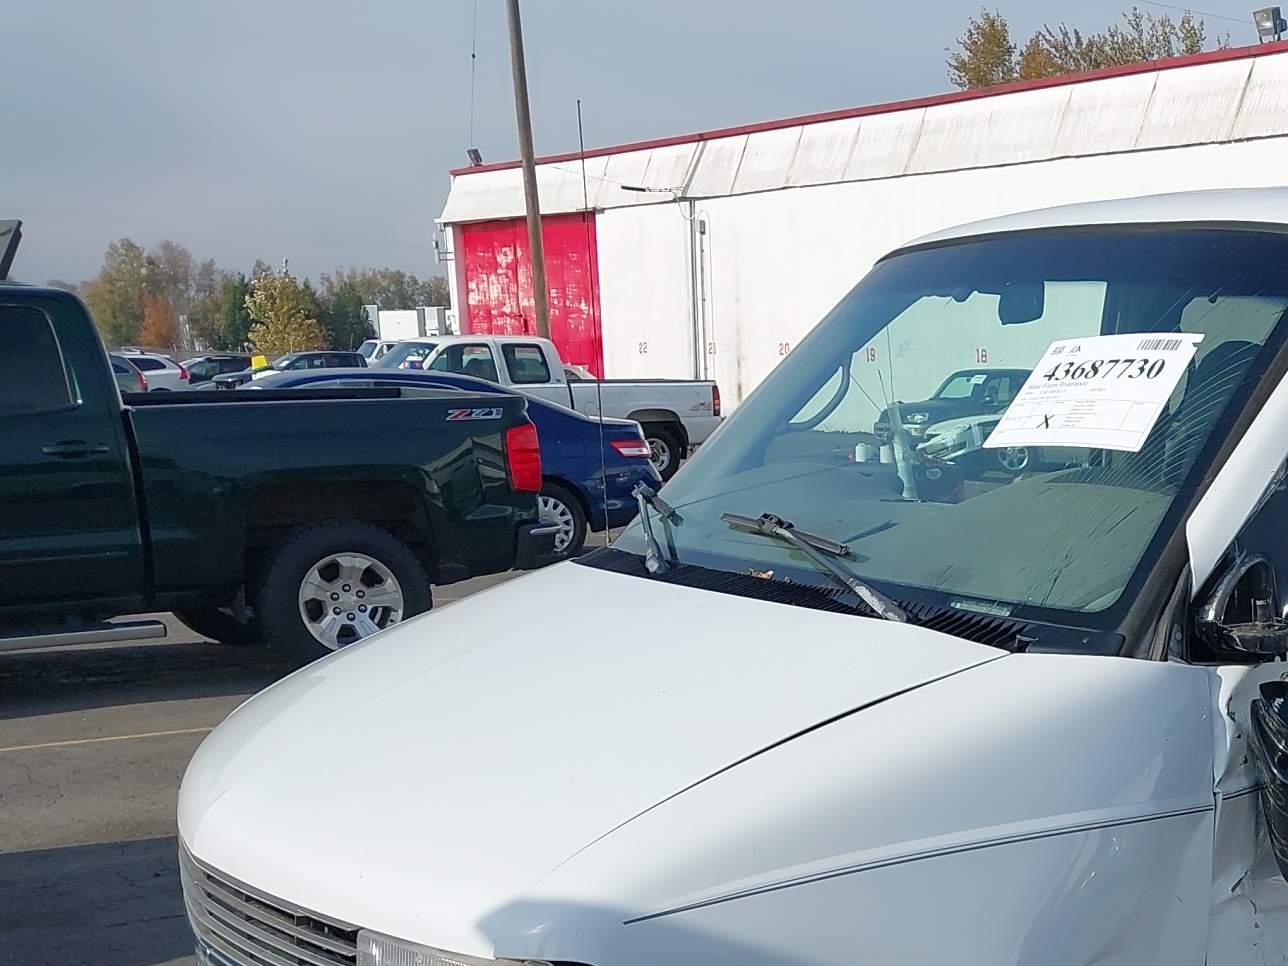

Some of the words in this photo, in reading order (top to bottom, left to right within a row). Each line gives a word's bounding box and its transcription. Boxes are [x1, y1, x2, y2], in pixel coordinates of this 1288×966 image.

[638, 341, 648, 354] 22
[778, 342, 790, 356] 20
[866, 347, 876, 362] 19
[976, 347, 988, 363] 18
[1043, 358, 1166, 381] 43687730
[1036, 413, 1056, 429] X
